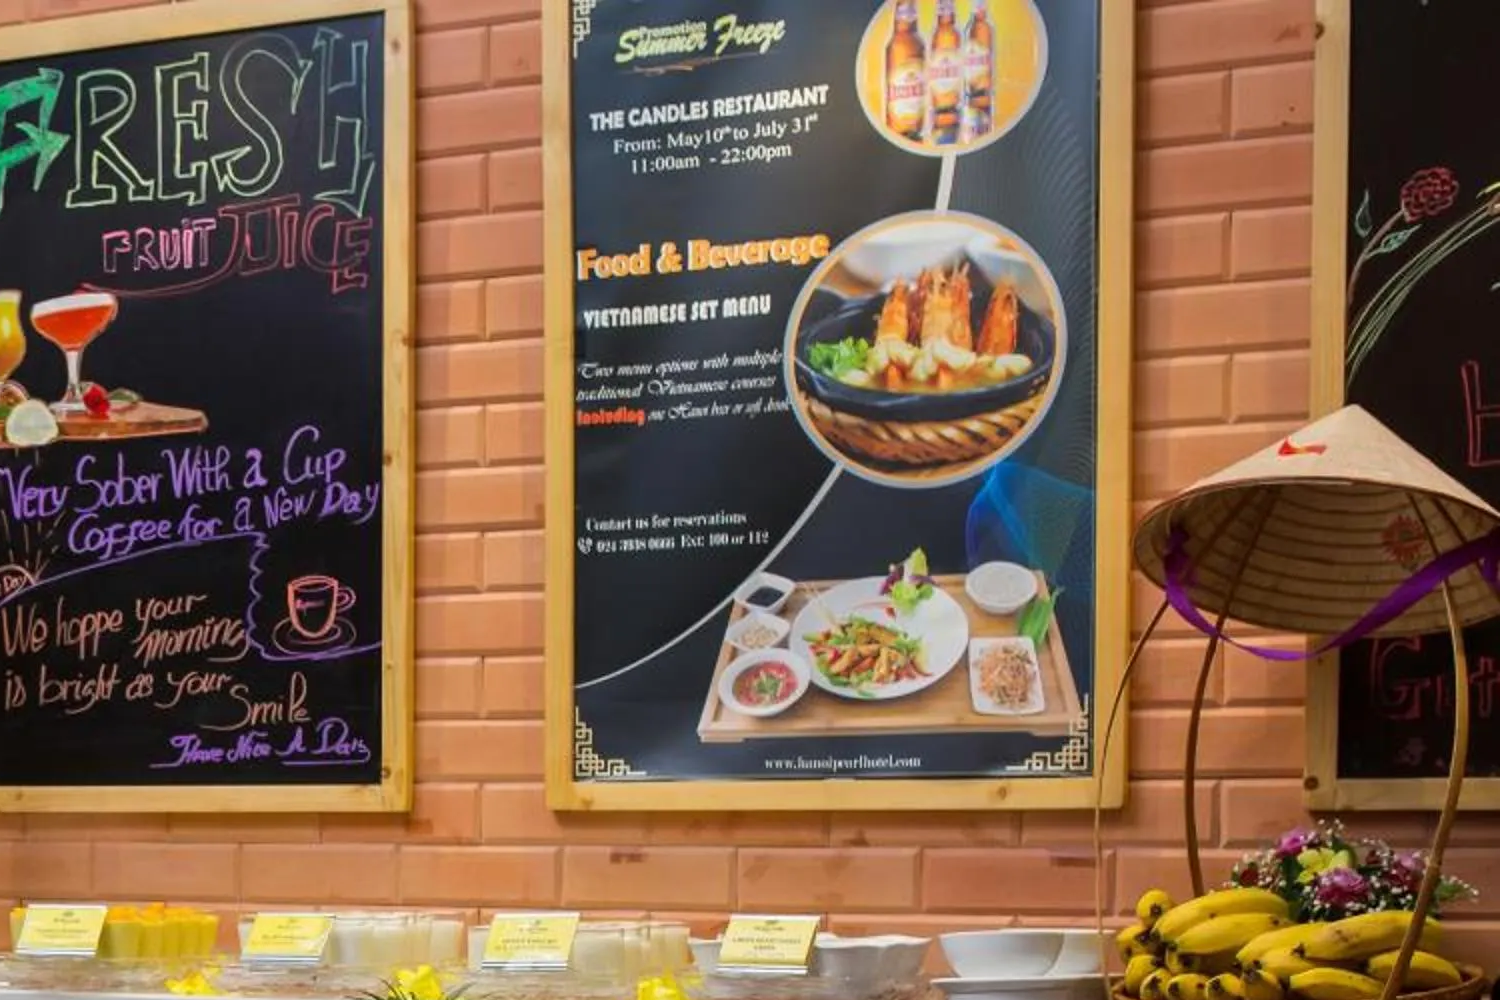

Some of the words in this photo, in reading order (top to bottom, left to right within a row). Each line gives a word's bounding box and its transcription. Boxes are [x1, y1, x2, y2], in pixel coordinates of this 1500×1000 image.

[614, 29, 707, 63] Summer
[713, 14, 786, 60] Freeze
[589, 109, 625, 131] THE
[628, 101, 709, 127] CANDLES
[713, 84, 830, 117] RESTAURANT
[613, 137, 662, 155] From:
[666, 128, 703, 150] May
[732, 127, 749, 141] to
[753, 120, 787, 142] July
[630, 153, 701, 175] 11:00am
[720, 143, 792, 166] 22:00pm
[218, 194, 373, 293] JUICE
[576, 244, 652, 281] Food
[656, 241, 683, 274] &
[687, 233, 832, 271] Beverage
[583, 303, 687, 330] VIETNAMESE
[691, 300, 719, 322] SET
[722, 294, 771, 318] MENU
[76, 453, 162, 513] Sober
[163, 446, 231, 499] With
[243, 449, 267, 487] a
[283, 425, 347, 484] Cup
[68, 511, 171, 558] Coffee
[178, 502, 223, 543] for
[234, 498, 255, 532] a
[264, 490, 316, 529] New
[319, 480, 380, 525] Day
[636, 517, 649, 529] us
[652, 514, 671, 529] for
[2, 601, 49, 658] We
[136, 593, 207, 639] your
[4, 668, 27, 711] is
[38, 664, 121, 715] bright
[125, 676, 155, 702] as
[154, 671, 233, 709] your
[200, 671, 311, 731] Smile
